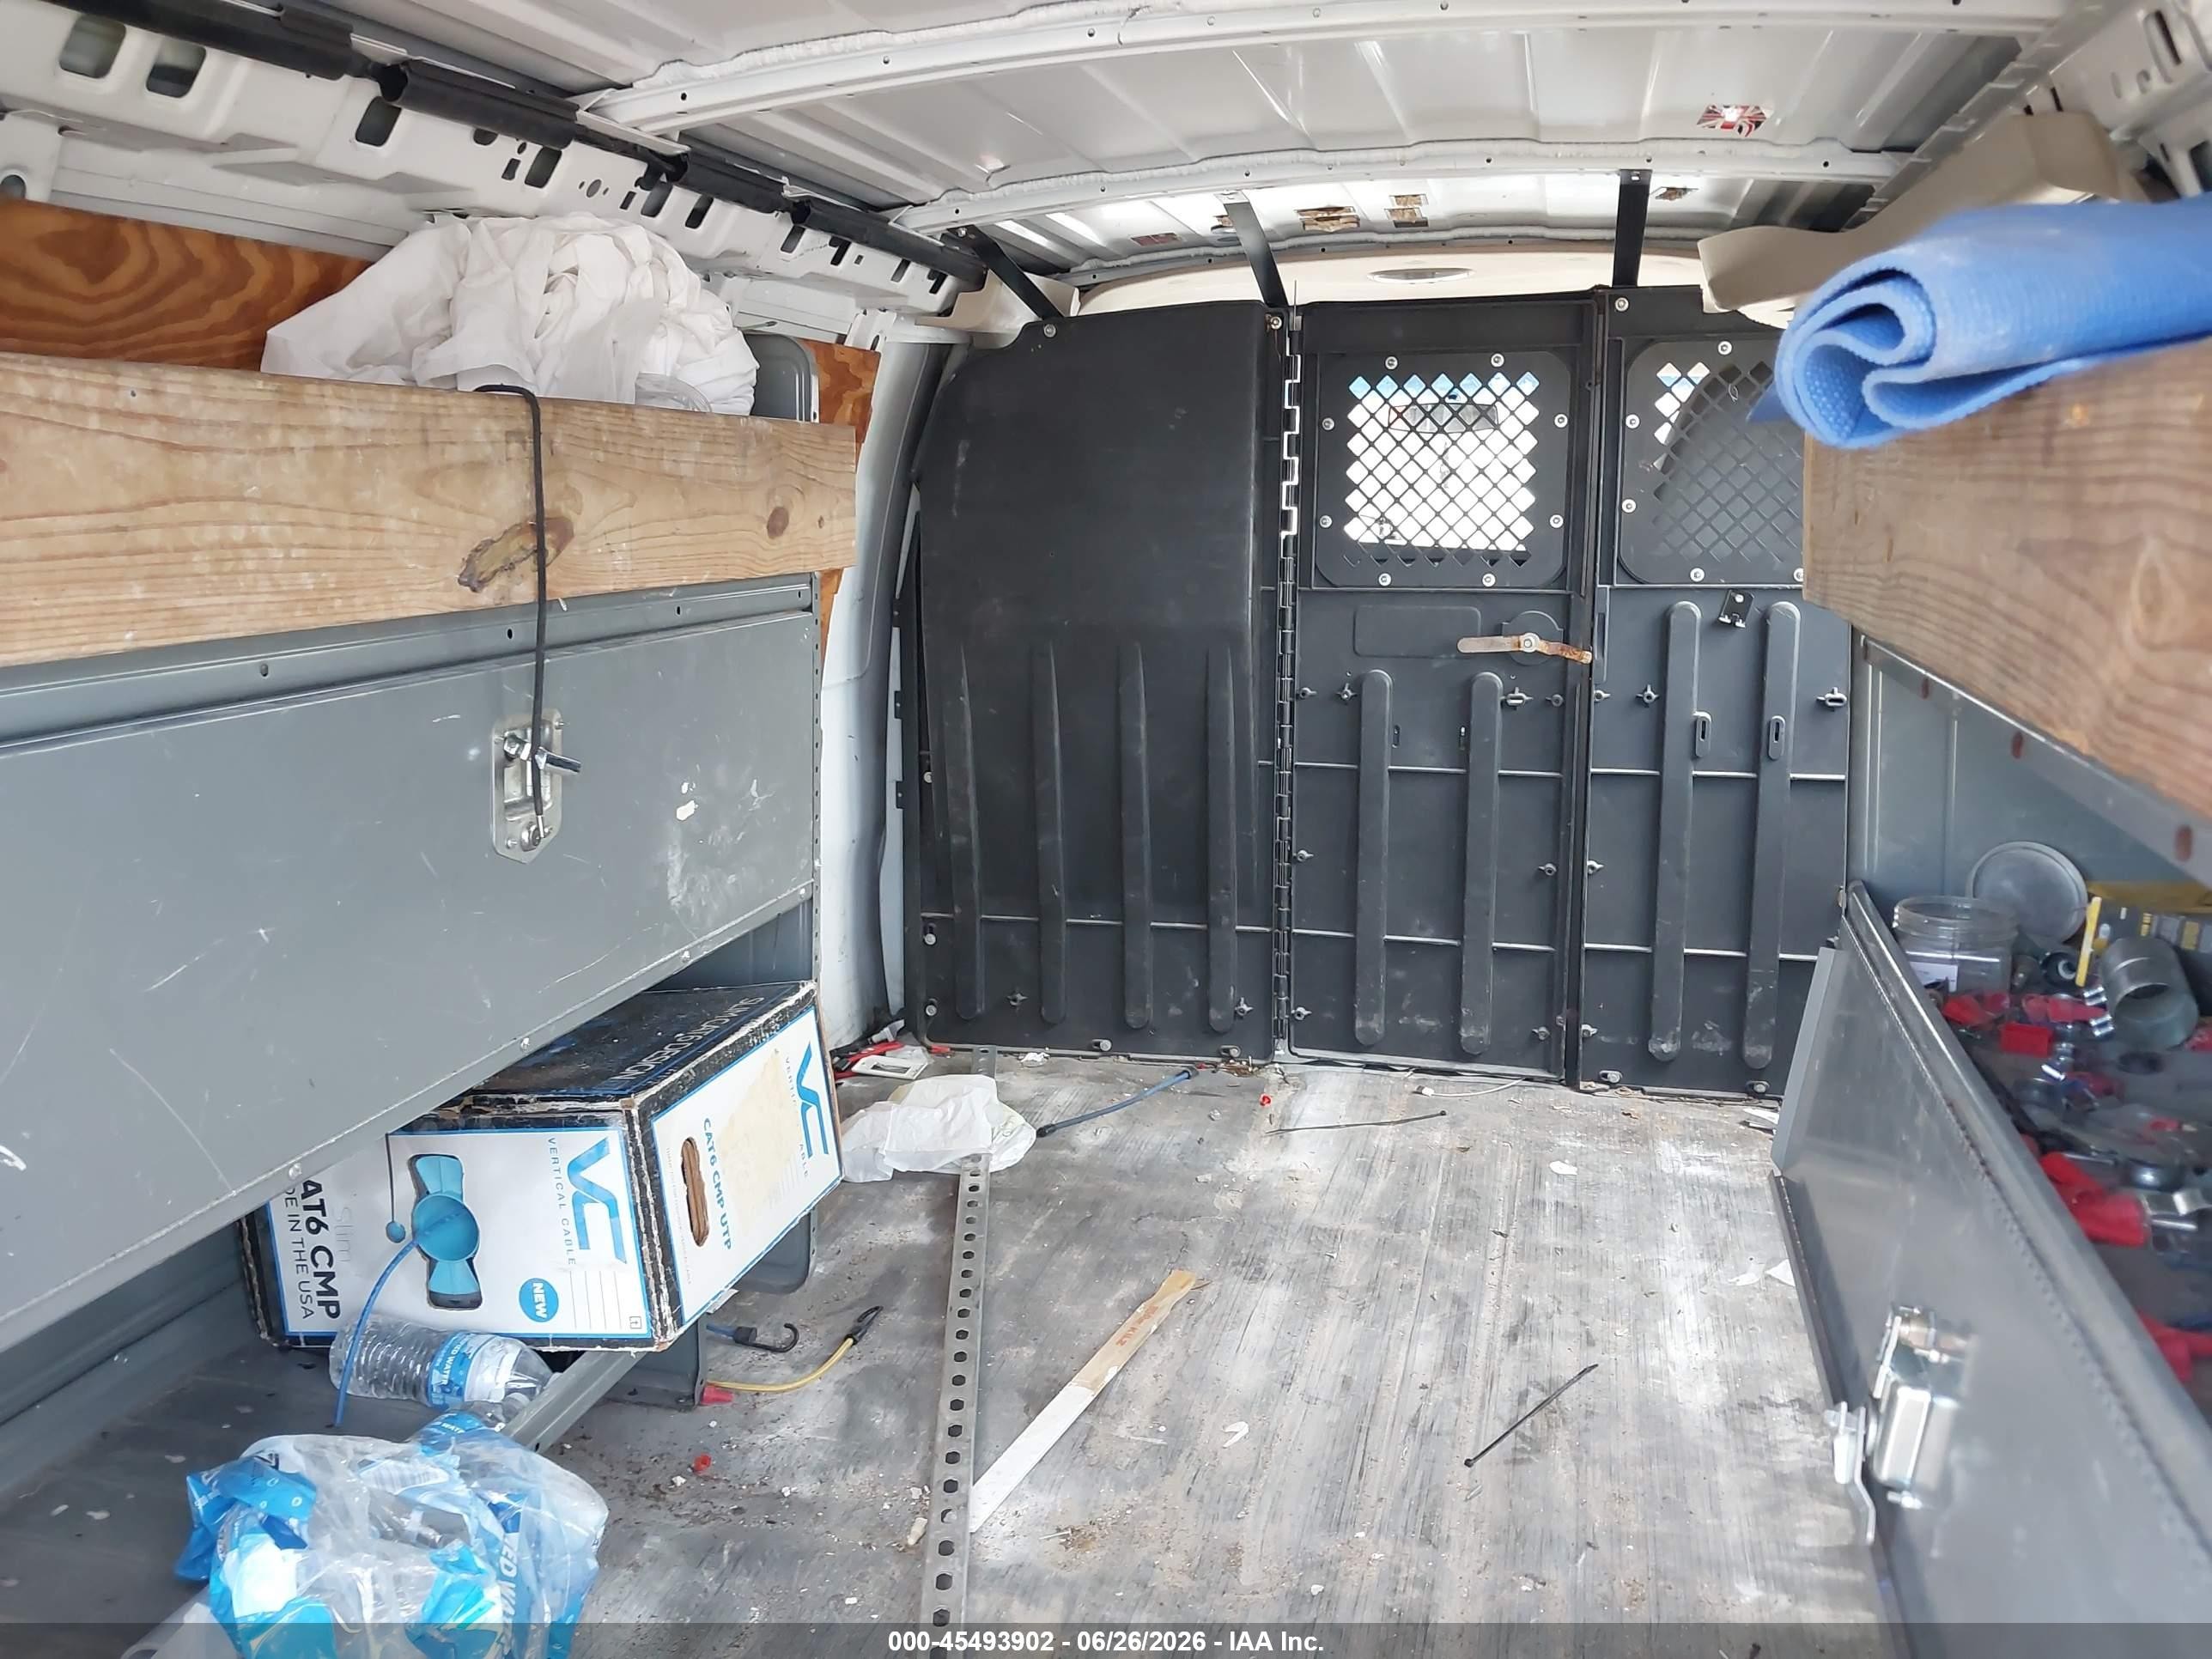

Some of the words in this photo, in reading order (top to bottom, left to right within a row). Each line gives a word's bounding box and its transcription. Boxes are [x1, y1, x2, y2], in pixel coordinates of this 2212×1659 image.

[725, 997, 764, 1017] SLIM
[611, 1042, 693, 1080] DESIGN
[796, 1042, 829, 1159] VC
[301, 1179, 329, 1235] AT6
[548, 1137, 567, 1210] VERTICAL
[562, 1218, 576, 1265] CABLE
[567, 1137, 628, 1264] VC
[703, 1117, 719, 1167] CAT6
[712, 1170, 725, 1209] CMP
[720, 1212, 732, 1250] UTP
[288, 1213, 302, 1232] IN
[291, 1237, 309, 1274] THE
[298, 1279, 315, 1320] USA
[310, 1244, 341, 1320] CMP
[532, 1282, 547, 1319] NEW
